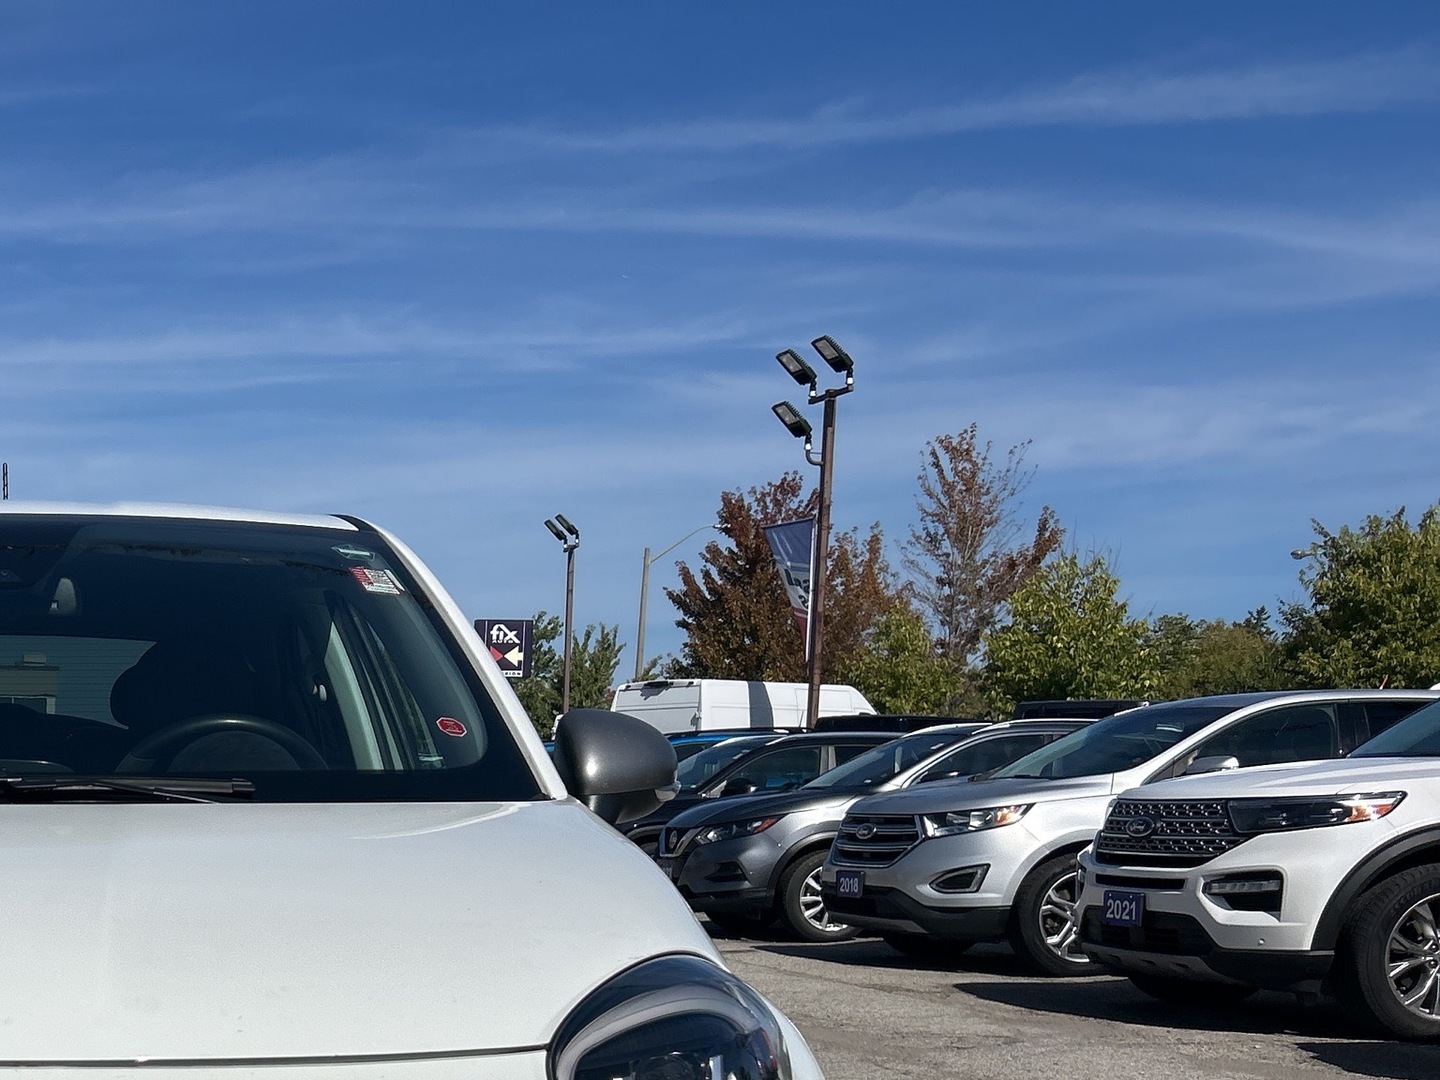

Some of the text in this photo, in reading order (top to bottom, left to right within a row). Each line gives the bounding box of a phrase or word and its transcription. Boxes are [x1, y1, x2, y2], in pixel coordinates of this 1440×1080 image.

[490, 623, 521, 644] fix
[840, 877, 859, 893] 2018
[1106, 899, 1136, 920] 2021
